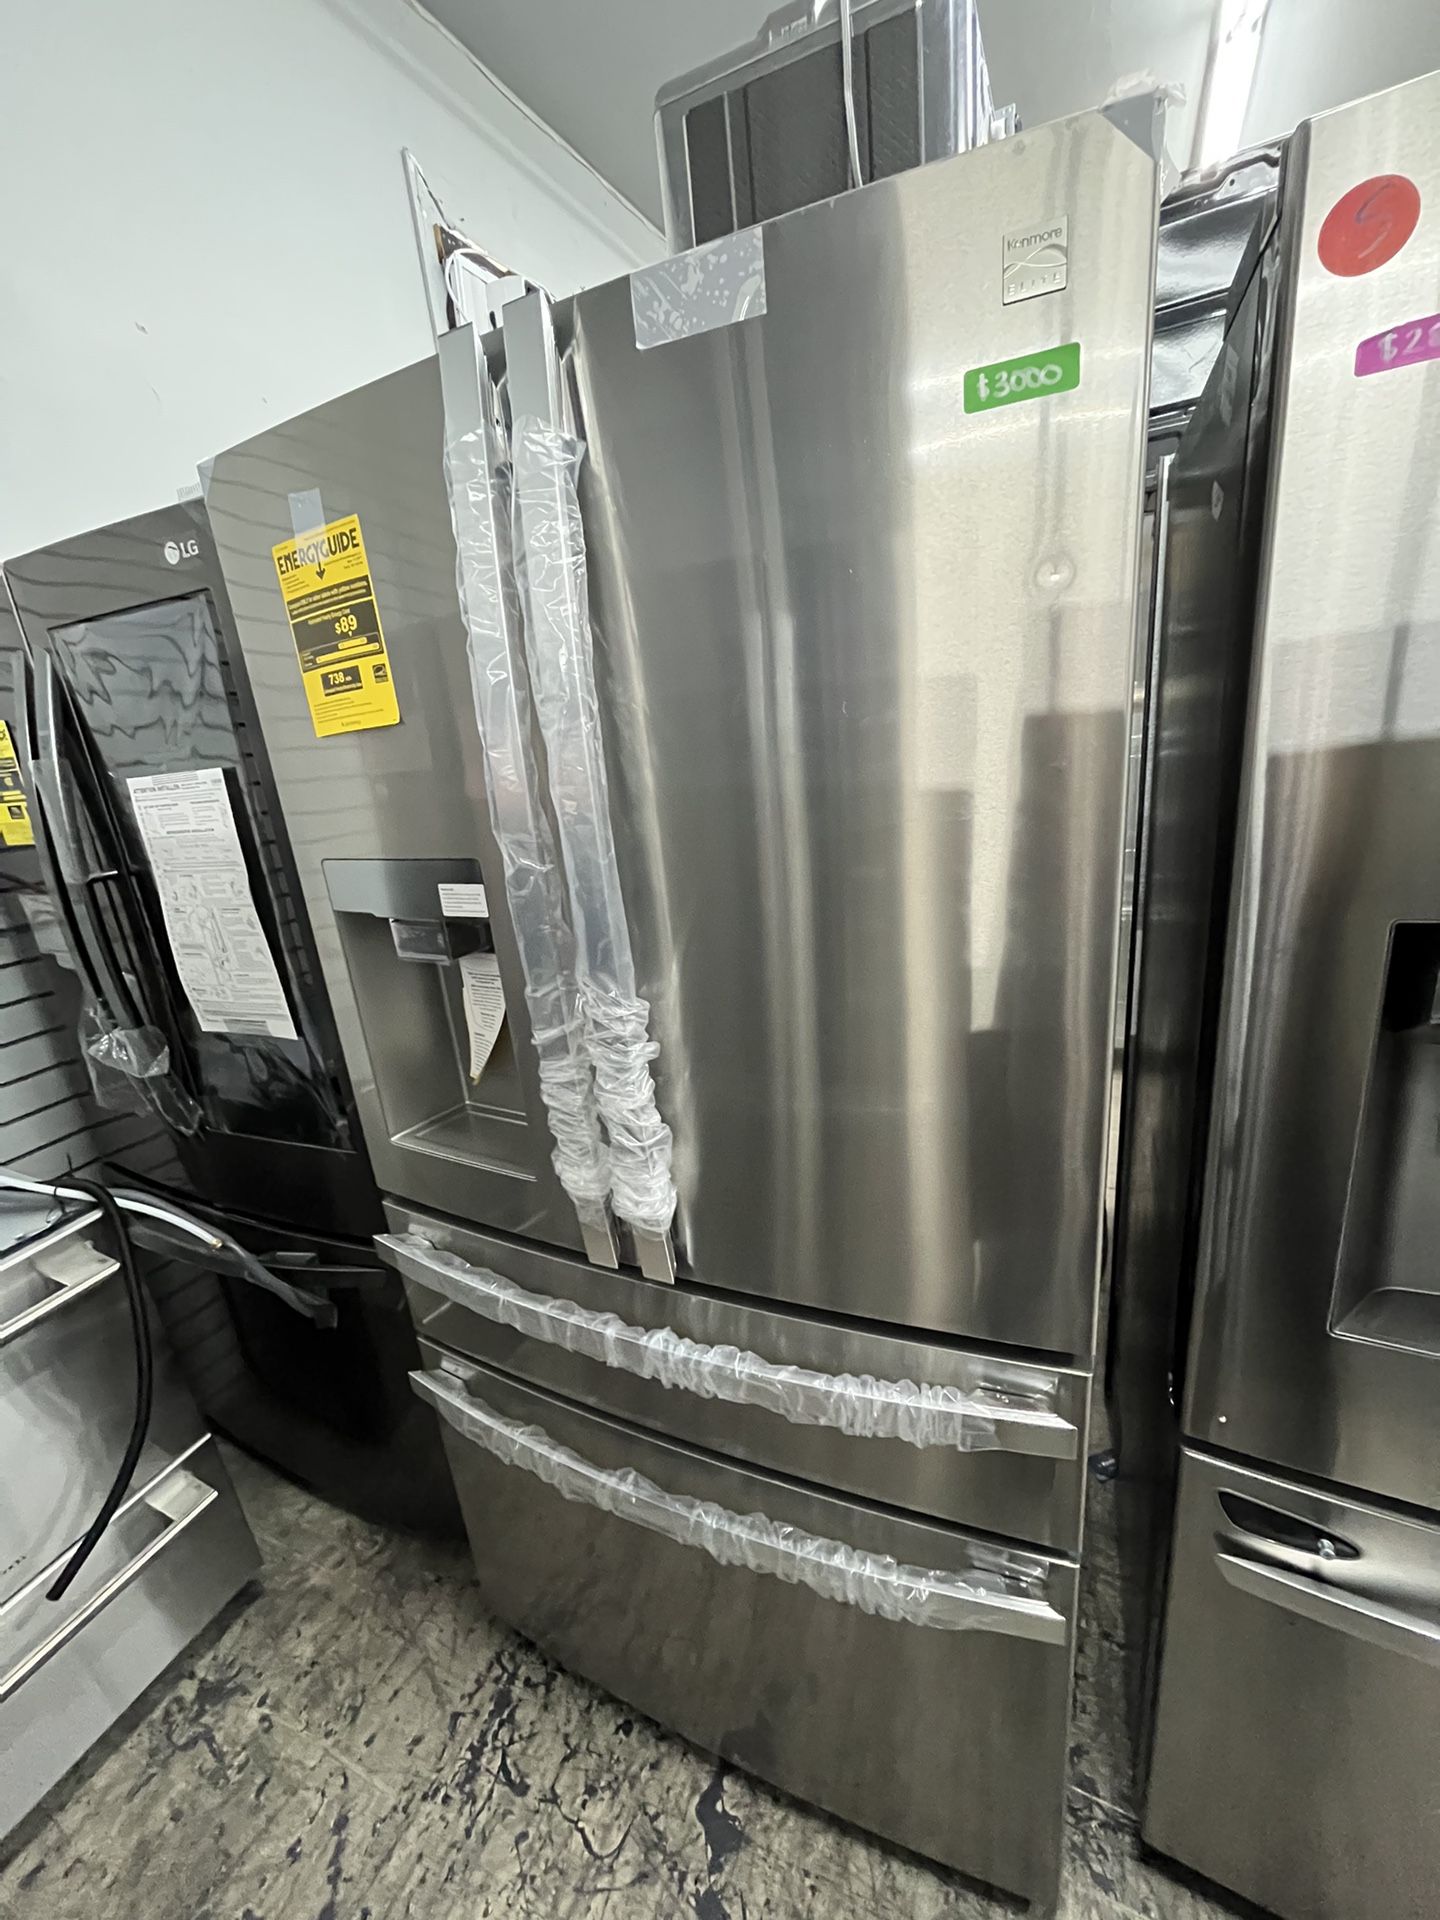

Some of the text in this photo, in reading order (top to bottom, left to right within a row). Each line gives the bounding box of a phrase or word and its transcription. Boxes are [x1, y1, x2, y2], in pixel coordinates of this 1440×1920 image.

[1007, 226, 1063, 252] Kenmore
[1008, 272, 1062, 297] ELITE
[976, 363, 1063, 402] $3000
[180, 539, 199, 559] LG
[334, 614, 358, 635] $89
[328, 671, 345, 686] 738
